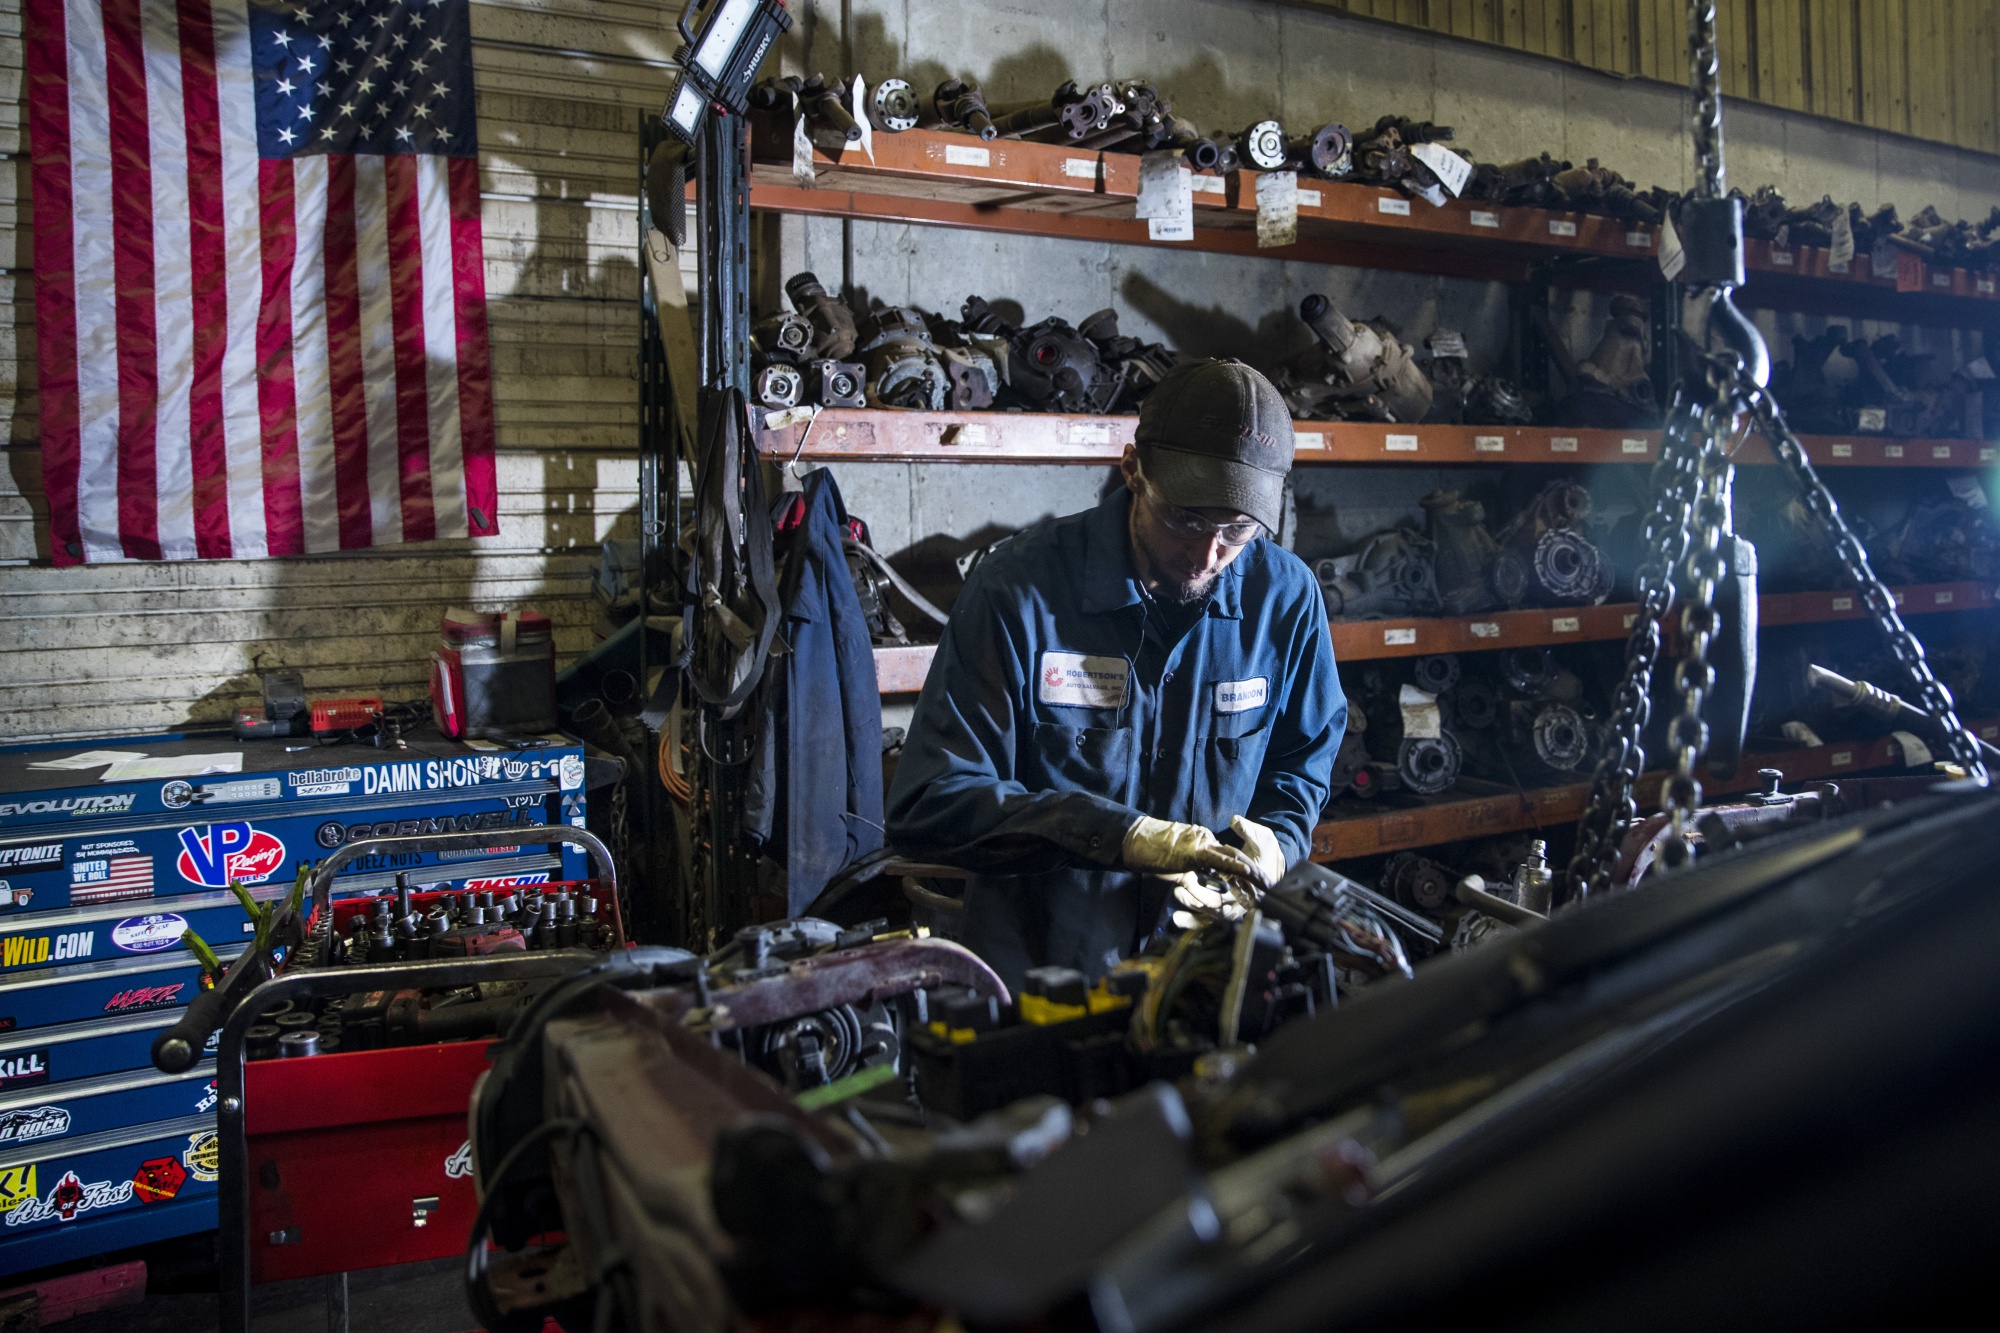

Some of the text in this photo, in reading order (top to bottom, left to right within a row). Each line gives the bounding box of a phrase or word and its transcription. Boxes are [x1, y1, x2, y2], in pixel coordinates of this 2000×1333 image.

[748, 33, 771, 71] HUSKY
[1066, 670, 1125, 680] ROBERTSON'S
[1221, 688, 1263, 702] BRANDON
[289, 768, 361, 786] hellabroke
[363, 757, 480, 795] DAMN SHON
[300, 786, 332, 794] SEND
[0, 794, 136, 816] EVOLUTION
[347, 810, 533, 842] CORNWELL
[178, 821, 252, 887] VP
[229, 848, 281, 877] Racing
[73, 860, 107, 873] UNITED
[73, 871, 107, 882] WE ROLL
[464, 873, 549, 890] AMSOIL
[16, 1117, 66, 1136] ROCK
[8, 1199, 55, 1224] Art
[78, 1181, 132, 1208] Fast
